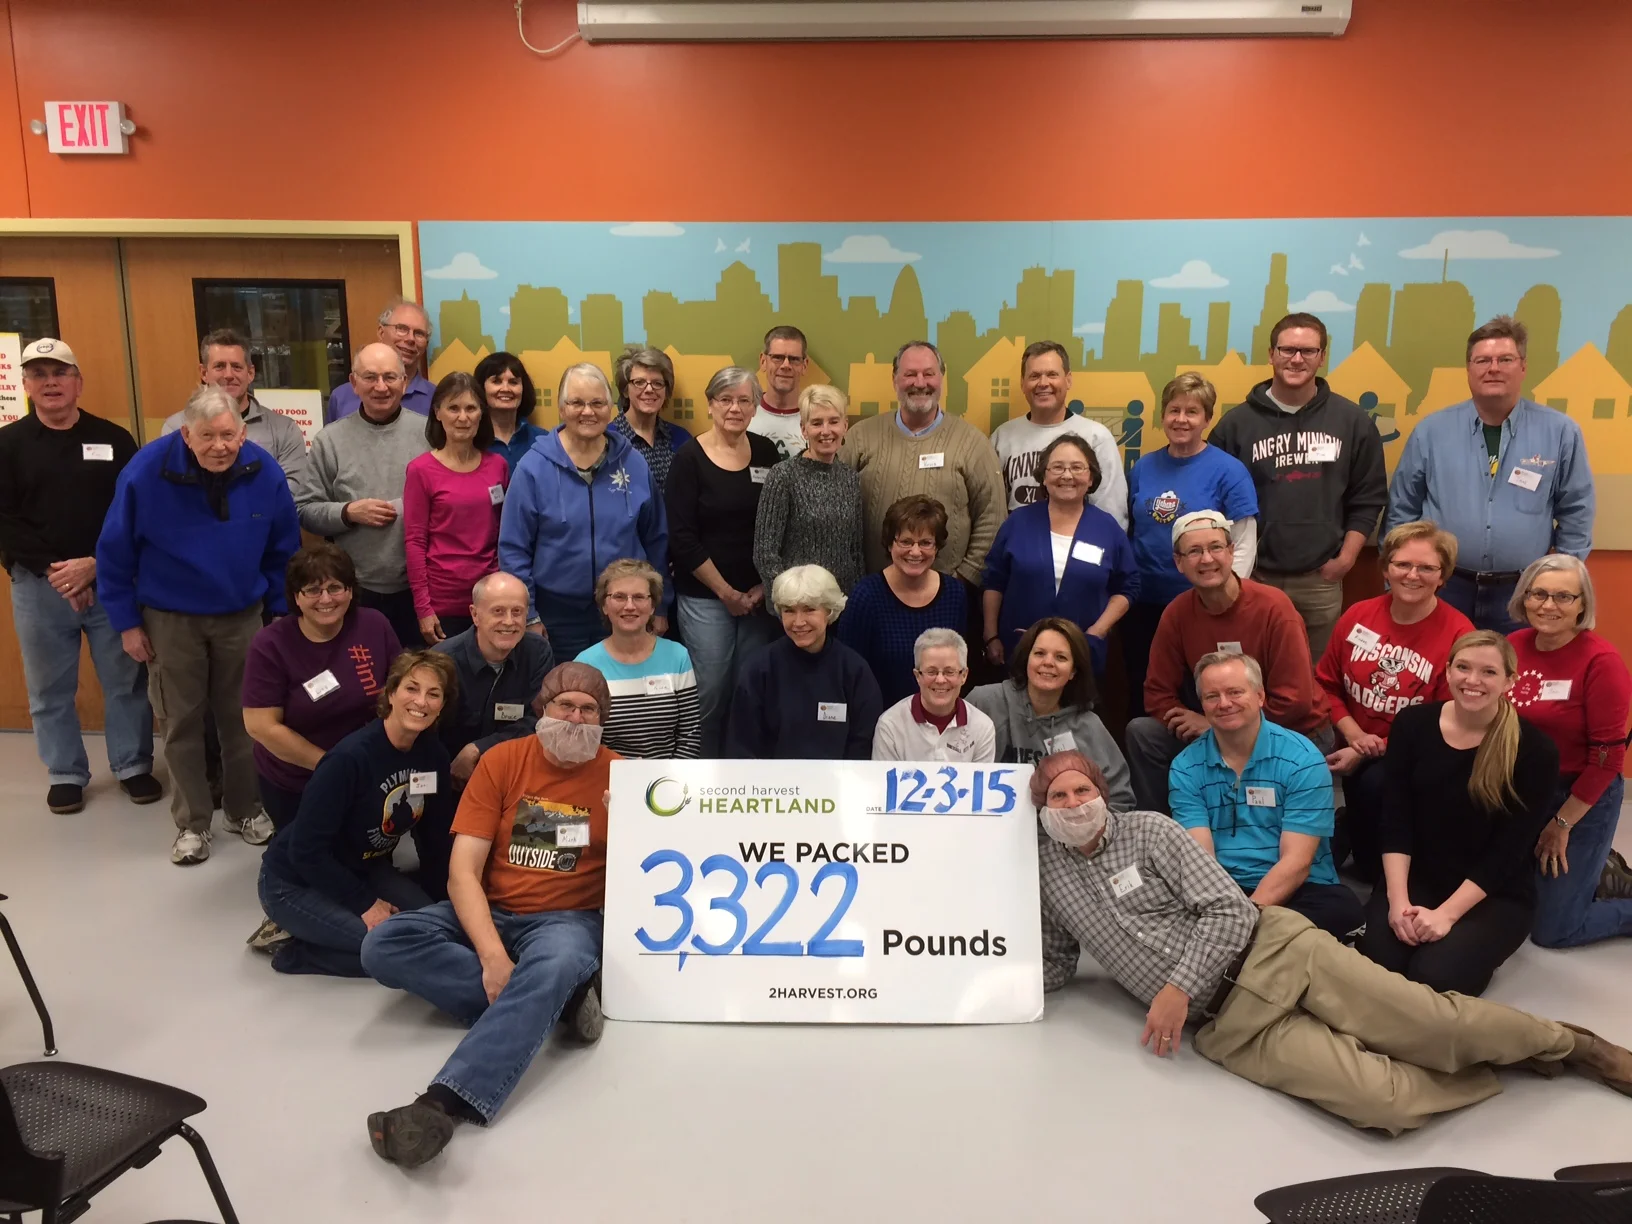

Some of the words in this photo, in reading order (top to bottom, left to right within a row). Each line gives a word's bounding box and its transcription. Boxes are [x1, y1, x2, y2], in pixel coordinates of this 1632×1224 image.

[58, 104, 109, 147] EXIT
[1252, 432, 1292, 463] ANGRY
[1023, 487, 1037, 503] XL
[1152, 511, 1175, 524] UNITED
[1350, 642, 1434, 684] WISCONSIN
[699, 785, 746, 796] second
[752, 785, 801, 796] harvest
[885, 766, 1018, 813] 12-3-15
[699, 798, 836, 814] HEARTLAND
[508, 843, 558, 869] OUTSIDE
[739, 842, 786, 863] WE
[796, 842, 909, 864] PACKED
[634, 849, 865, 972] 3,322
[882, 929, 1007, 957] Pounds
[768, 987, 878, 999] 2HARVEST.ORG
